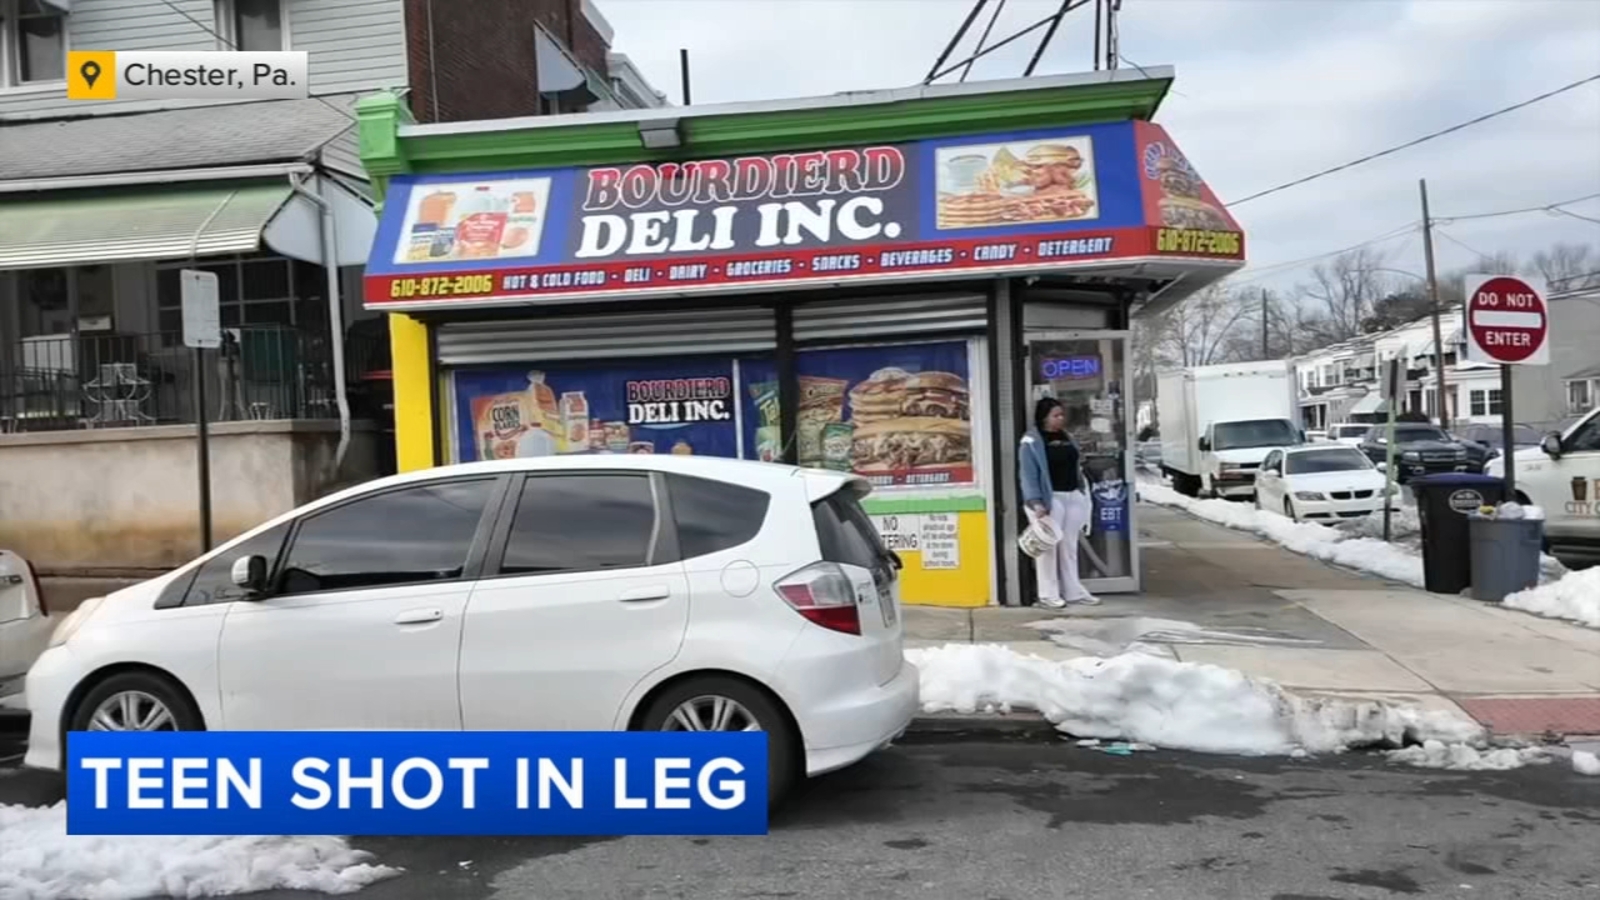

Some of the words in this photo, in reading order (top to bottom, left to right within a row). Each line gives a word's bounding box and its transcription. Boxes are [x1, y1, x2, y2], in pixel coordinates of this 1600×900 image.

[583, 146, 904, 211] BOURDIERD
[575, 206, 738, 258] DELI
[755, 197, 901, 247] INC.
[390, 274, 493, 298] 610-872-2006
[503, 275, 526, 290] HOT
[529, 274, 539, 290] &
[543, 272, 571, 288] COLD
[574, 270, 605, 286] FOOD
[624, 267, 650, 283] DELI
[669, 264, 708, 280] DAIRY
[726, 259, 792, 277] GROCERIES
[812, 253, 860, 271] SNACKS
[880, 249, 953, 267] BEVERAGES
[973, 244, 1017, 261] CANDY
[1037, 238, 1112, 257] DETERGENT
[1478, 292, 1499, 306] DO
[1506, 293, 1534, 308] NOT
[1485, 331, 1531, 347] ENTER
[1042, 359, 1099, 377] OPEN
[626, 377, 731, 402] BOURDIERD
[493, 405, 520, 421] CORN
[628, 402, 680, 424] DELI
[683, 400, 730, 421] INC.
[1101, 507, 1123, 521] EBT
[1565, 501, 1592, 515] CITY
[882, 516, 899, 531] NO
[881, 533, 918, 549] TERING
